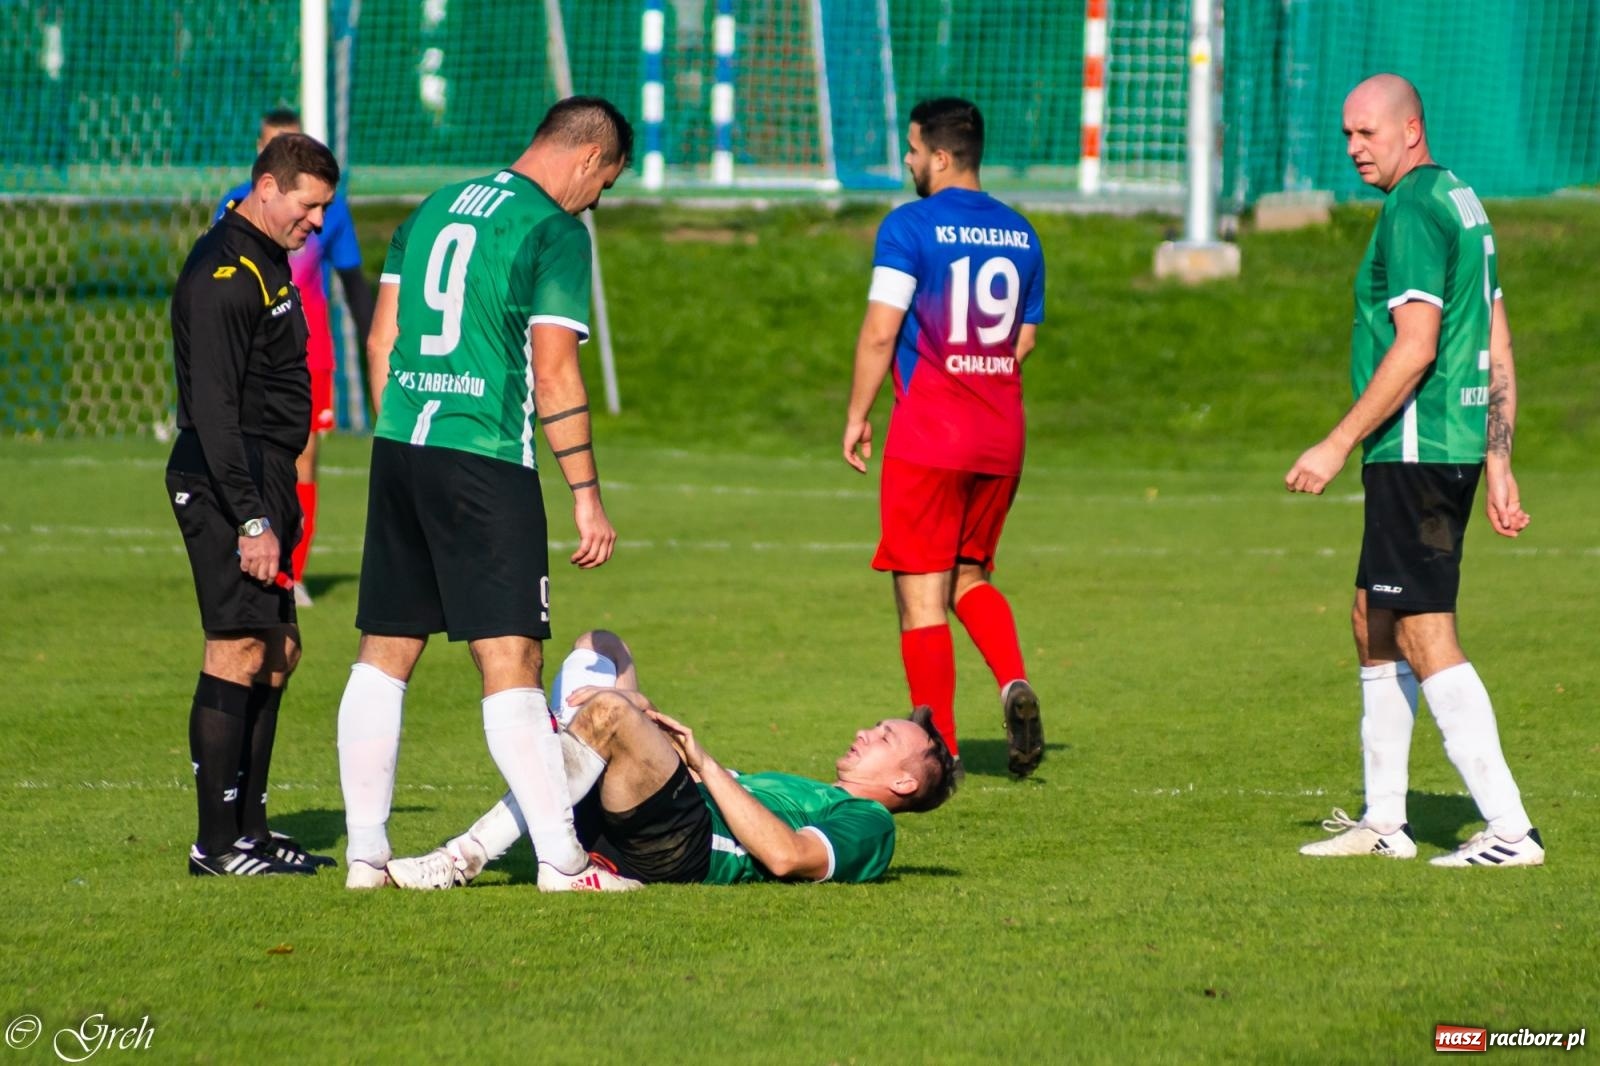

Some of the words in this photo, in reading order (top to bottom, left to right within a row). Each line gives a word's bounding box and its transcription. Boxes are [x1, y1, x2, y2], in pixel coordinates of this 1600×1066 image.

[448, 183, 516, 218] HILT
[935, 225, 957, 244] KS
[959, 226, 1030, 249] KOLEJARZ
[420, 222, 477, 356] 9
[947, 256, 1021, 347] 19
